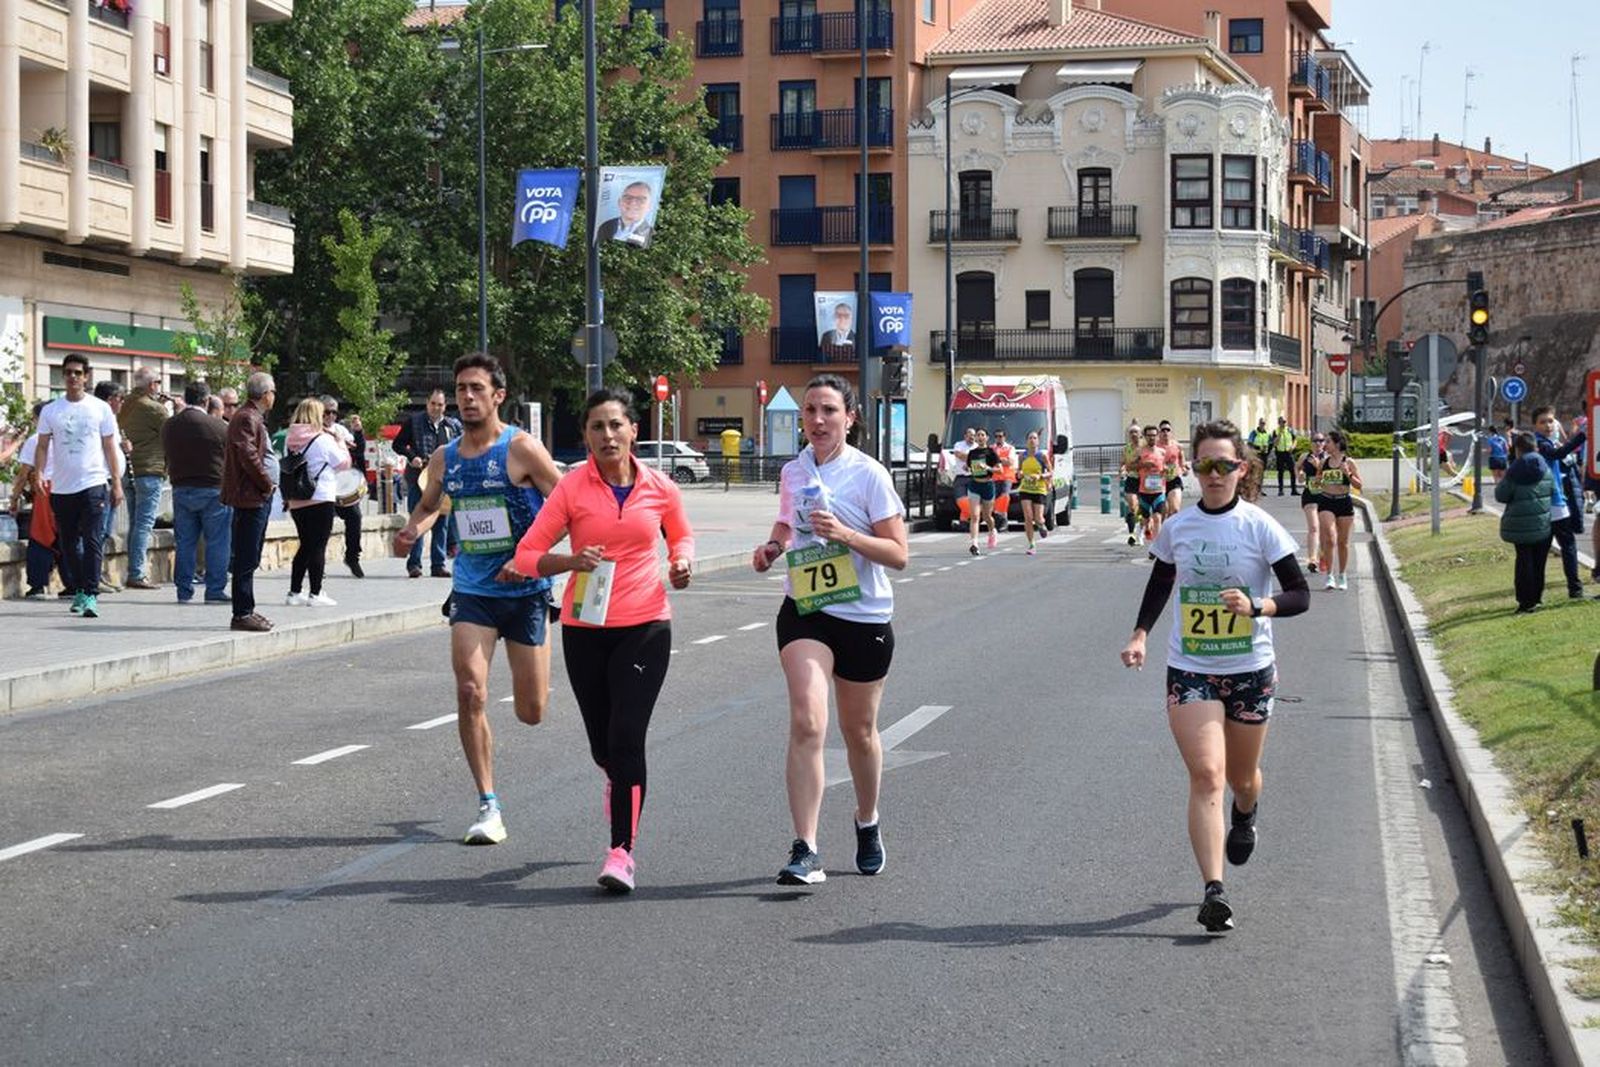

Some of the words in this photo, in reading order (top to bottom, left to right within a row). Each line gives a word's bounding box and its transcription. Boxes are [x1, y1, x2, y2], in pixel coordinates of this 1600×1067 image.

[526, 187, 563, 198] VOTA
[879, 306, 904, 315] VOTA
[804, 563, 838, 591] 79
[1190, 608, 1237, 634] 217
[1200, 642, 1220, 650] CAJA
[1221, 641, 1249, 650] RURAL
